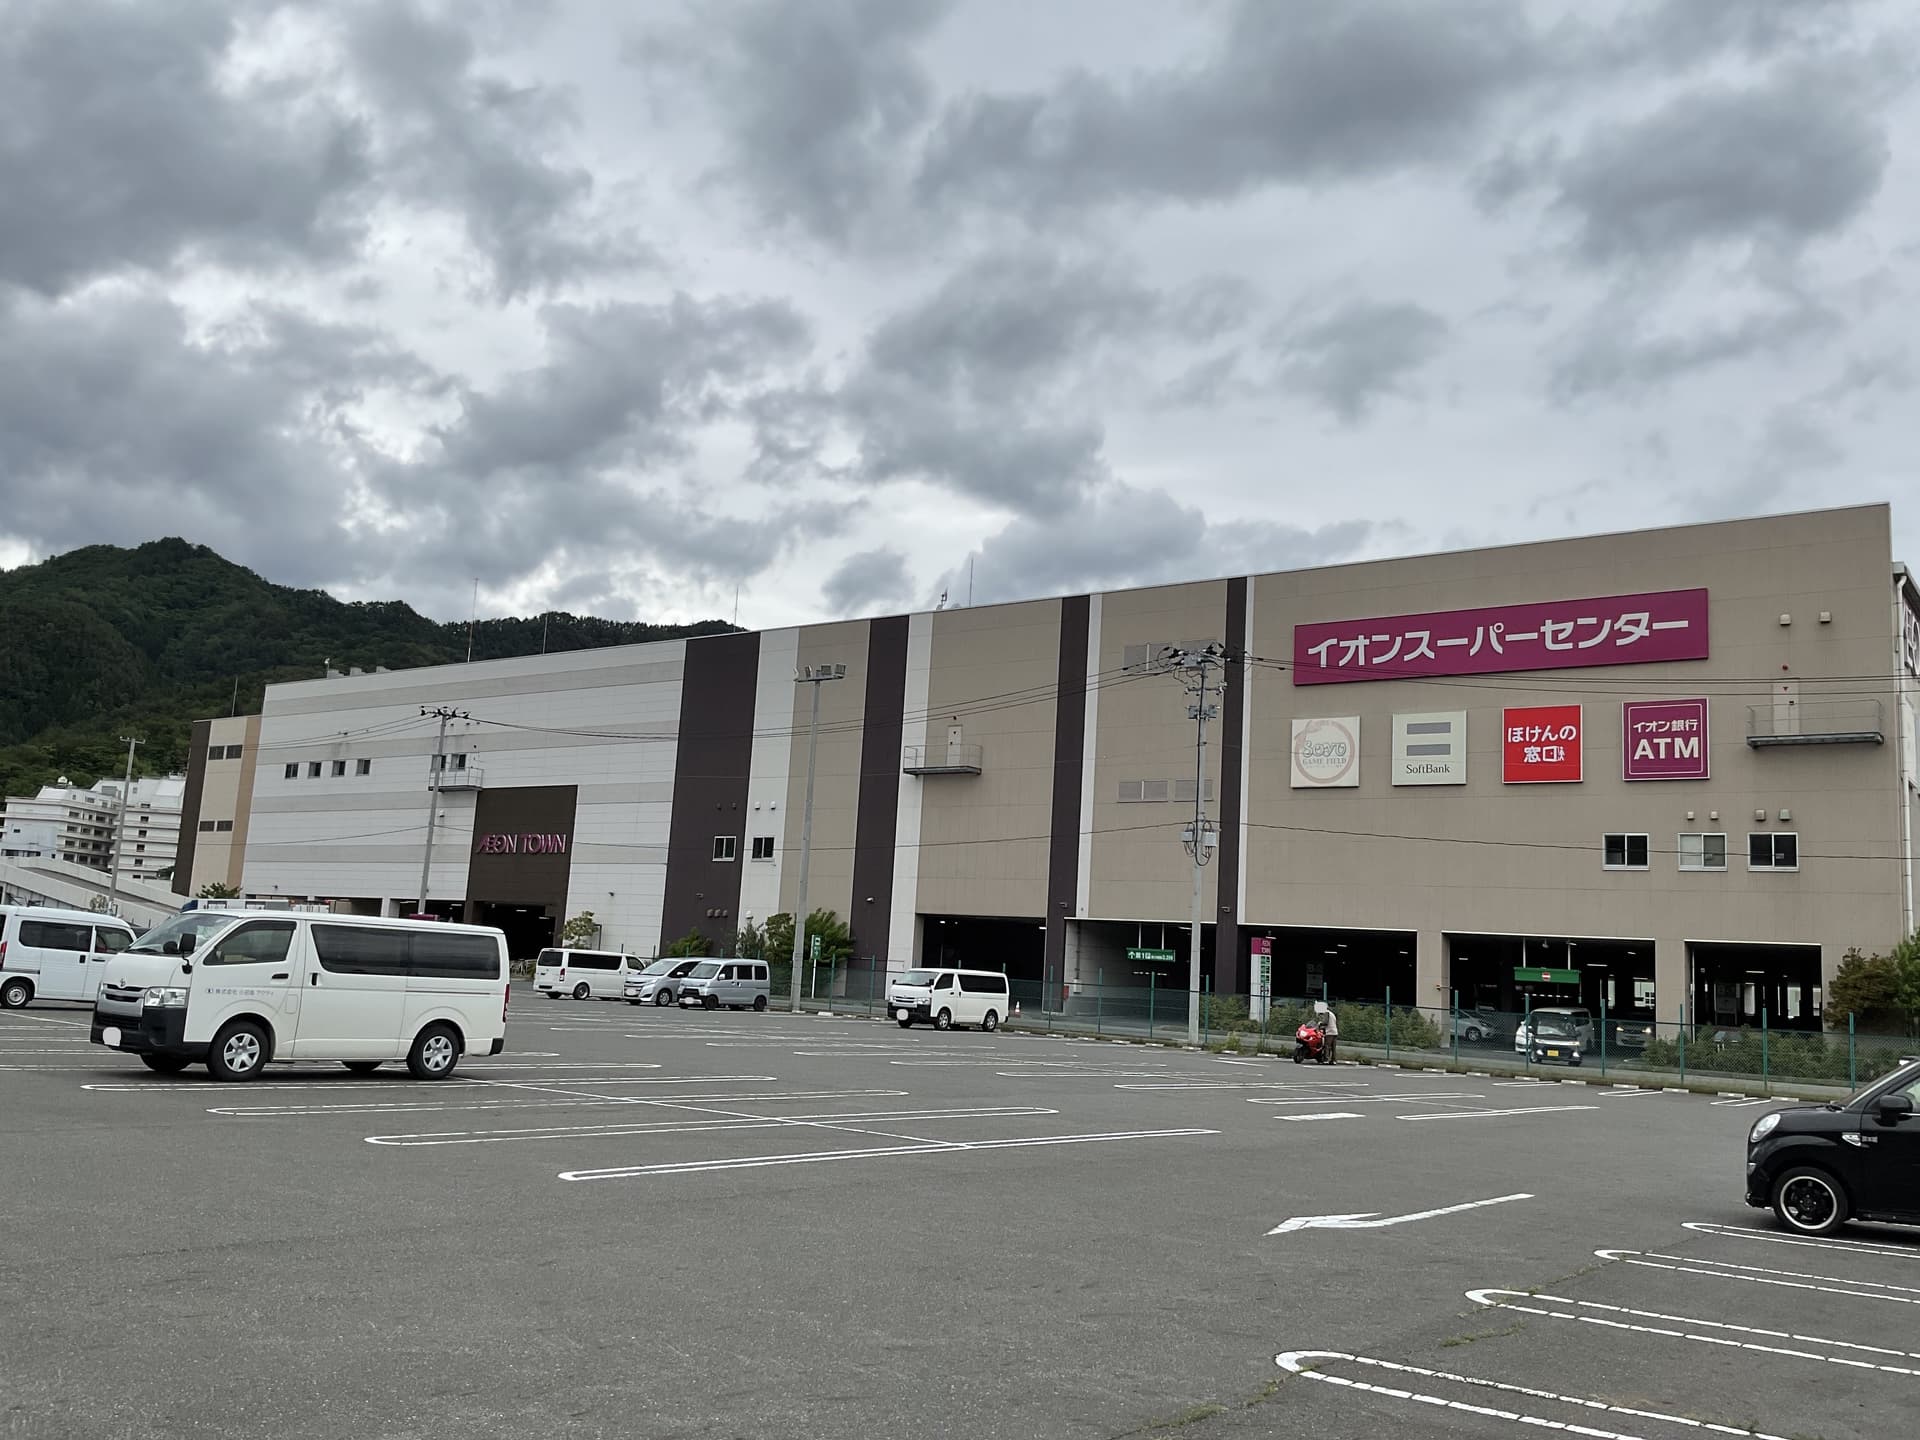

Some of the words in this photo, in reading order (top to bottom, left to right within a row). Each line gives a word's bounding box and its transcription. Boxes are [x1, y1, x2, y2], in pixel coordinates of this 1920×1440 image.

[1307, 612, 1689, 667] イオンスーパーセンター
[1507, 725, 1577, 743] ほけんの
[1633, 719, 1699, 733] イオン銀行
[1633, 737, 1699, 760] ATM
[1406, 763, 1451, 774] SoftBank
[520, 833, 567, 854] TOWN
